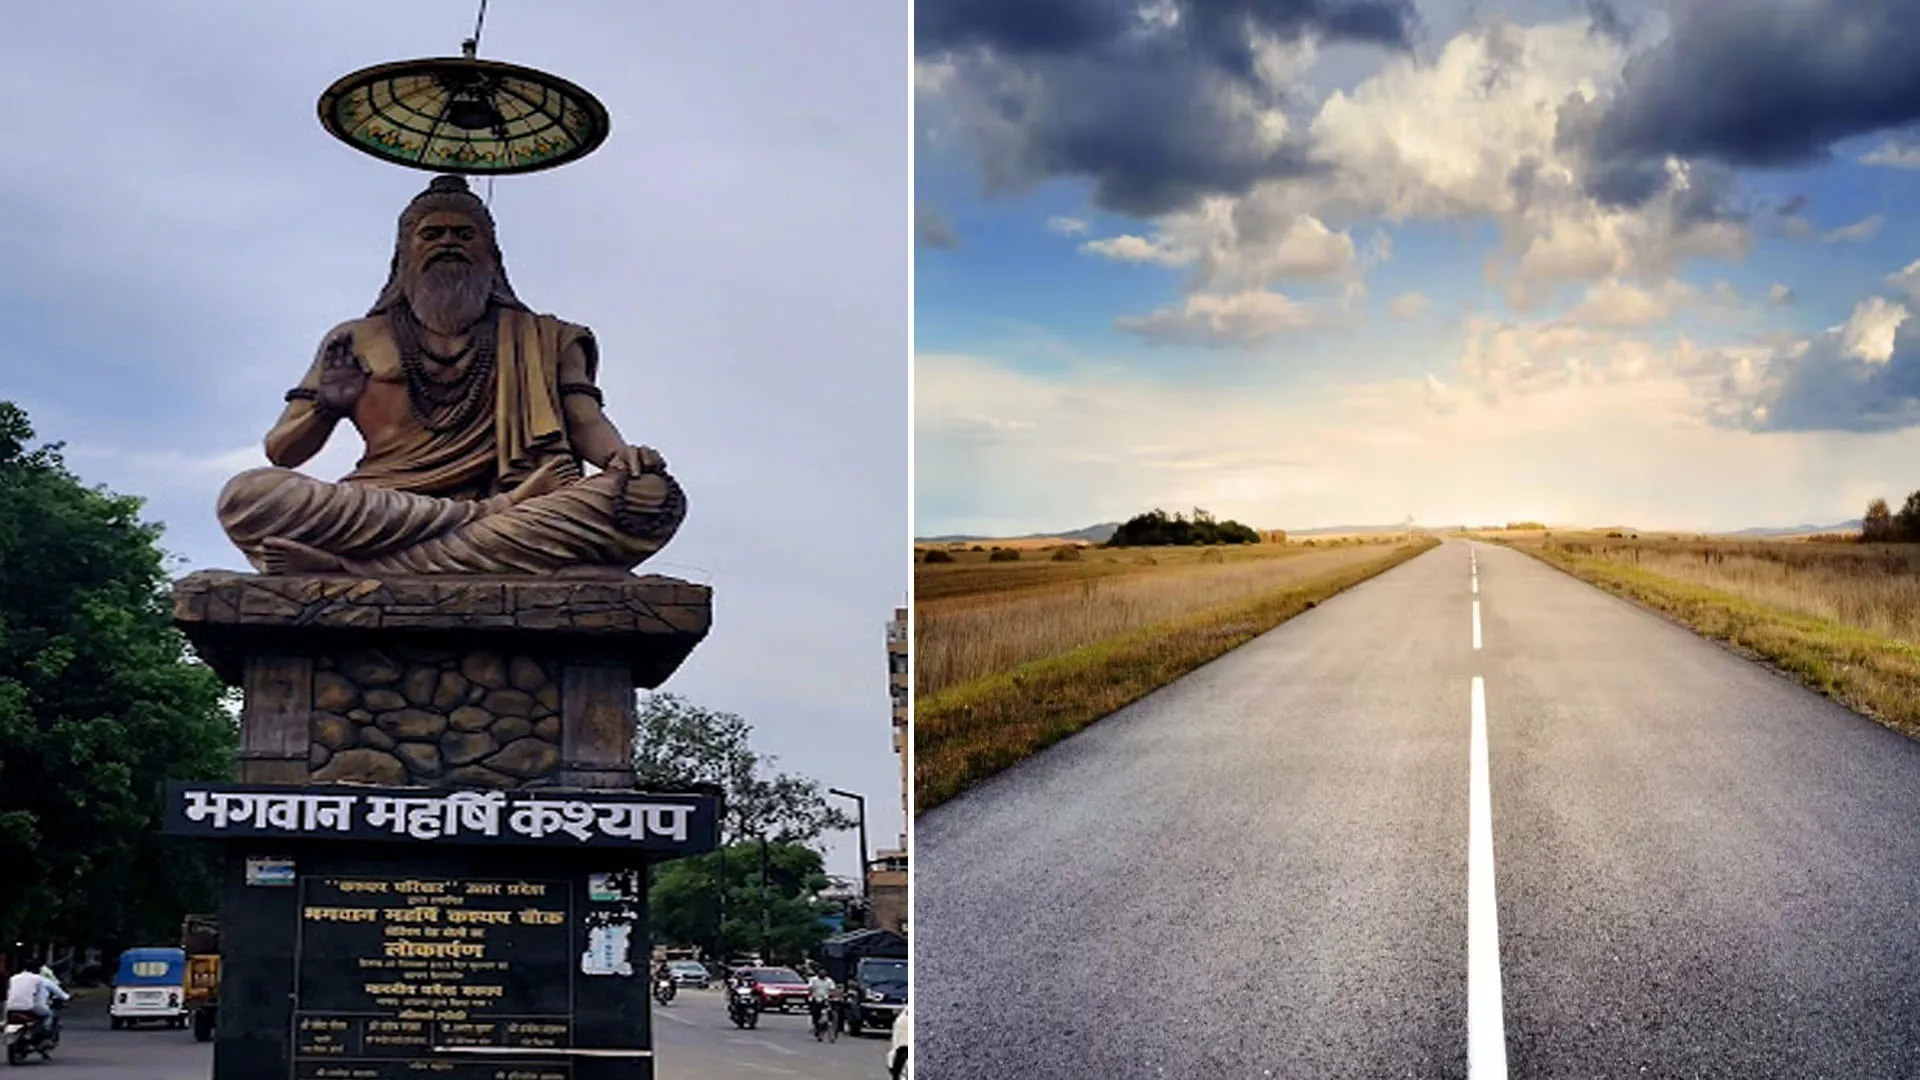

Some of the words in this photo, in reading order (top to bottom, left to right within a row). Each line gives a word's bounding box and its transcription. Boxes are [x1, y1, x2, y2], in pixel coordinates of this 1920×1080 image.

[184, 789, 357, 831] भगवान
[366, 789, 506, 839] महर्षि
[510, 799, 696, 843] कश्यप
[304, 906, 379, 922] भगवान
[384, 905, 440, 923] महर्षि
[447, 908, 513, 924] कश्यप
[383, 937, 486, 958] लोकार्पण
